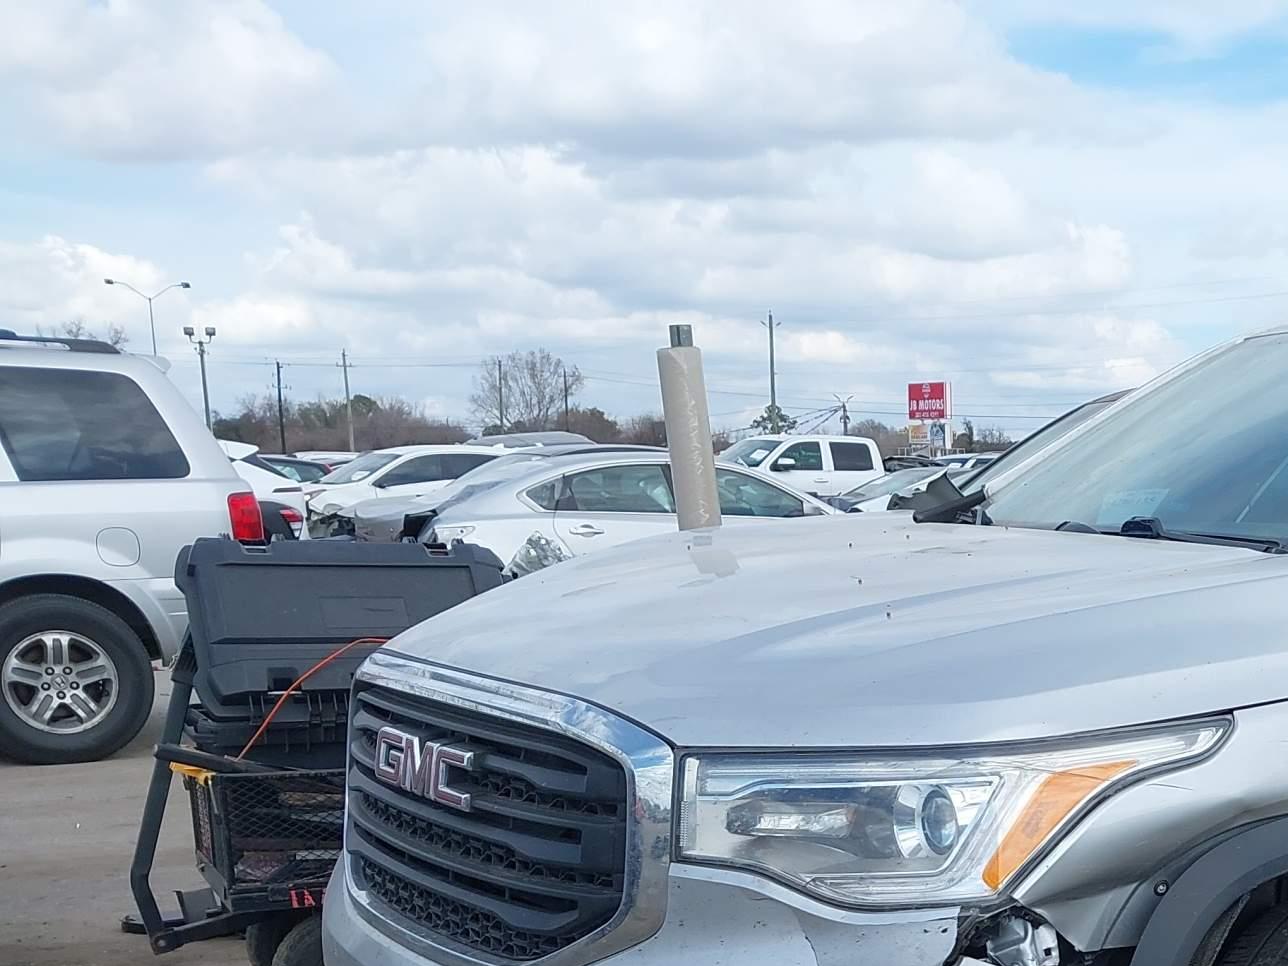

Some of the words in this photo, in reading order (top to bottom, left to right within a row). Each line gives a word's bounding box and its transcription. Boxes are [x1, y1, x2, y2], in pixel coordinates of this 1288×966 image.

[910, 399, 917, 411] JB
[919, 398, 943, 410] MOTORS
[375, 726, 474, 812] GMC
